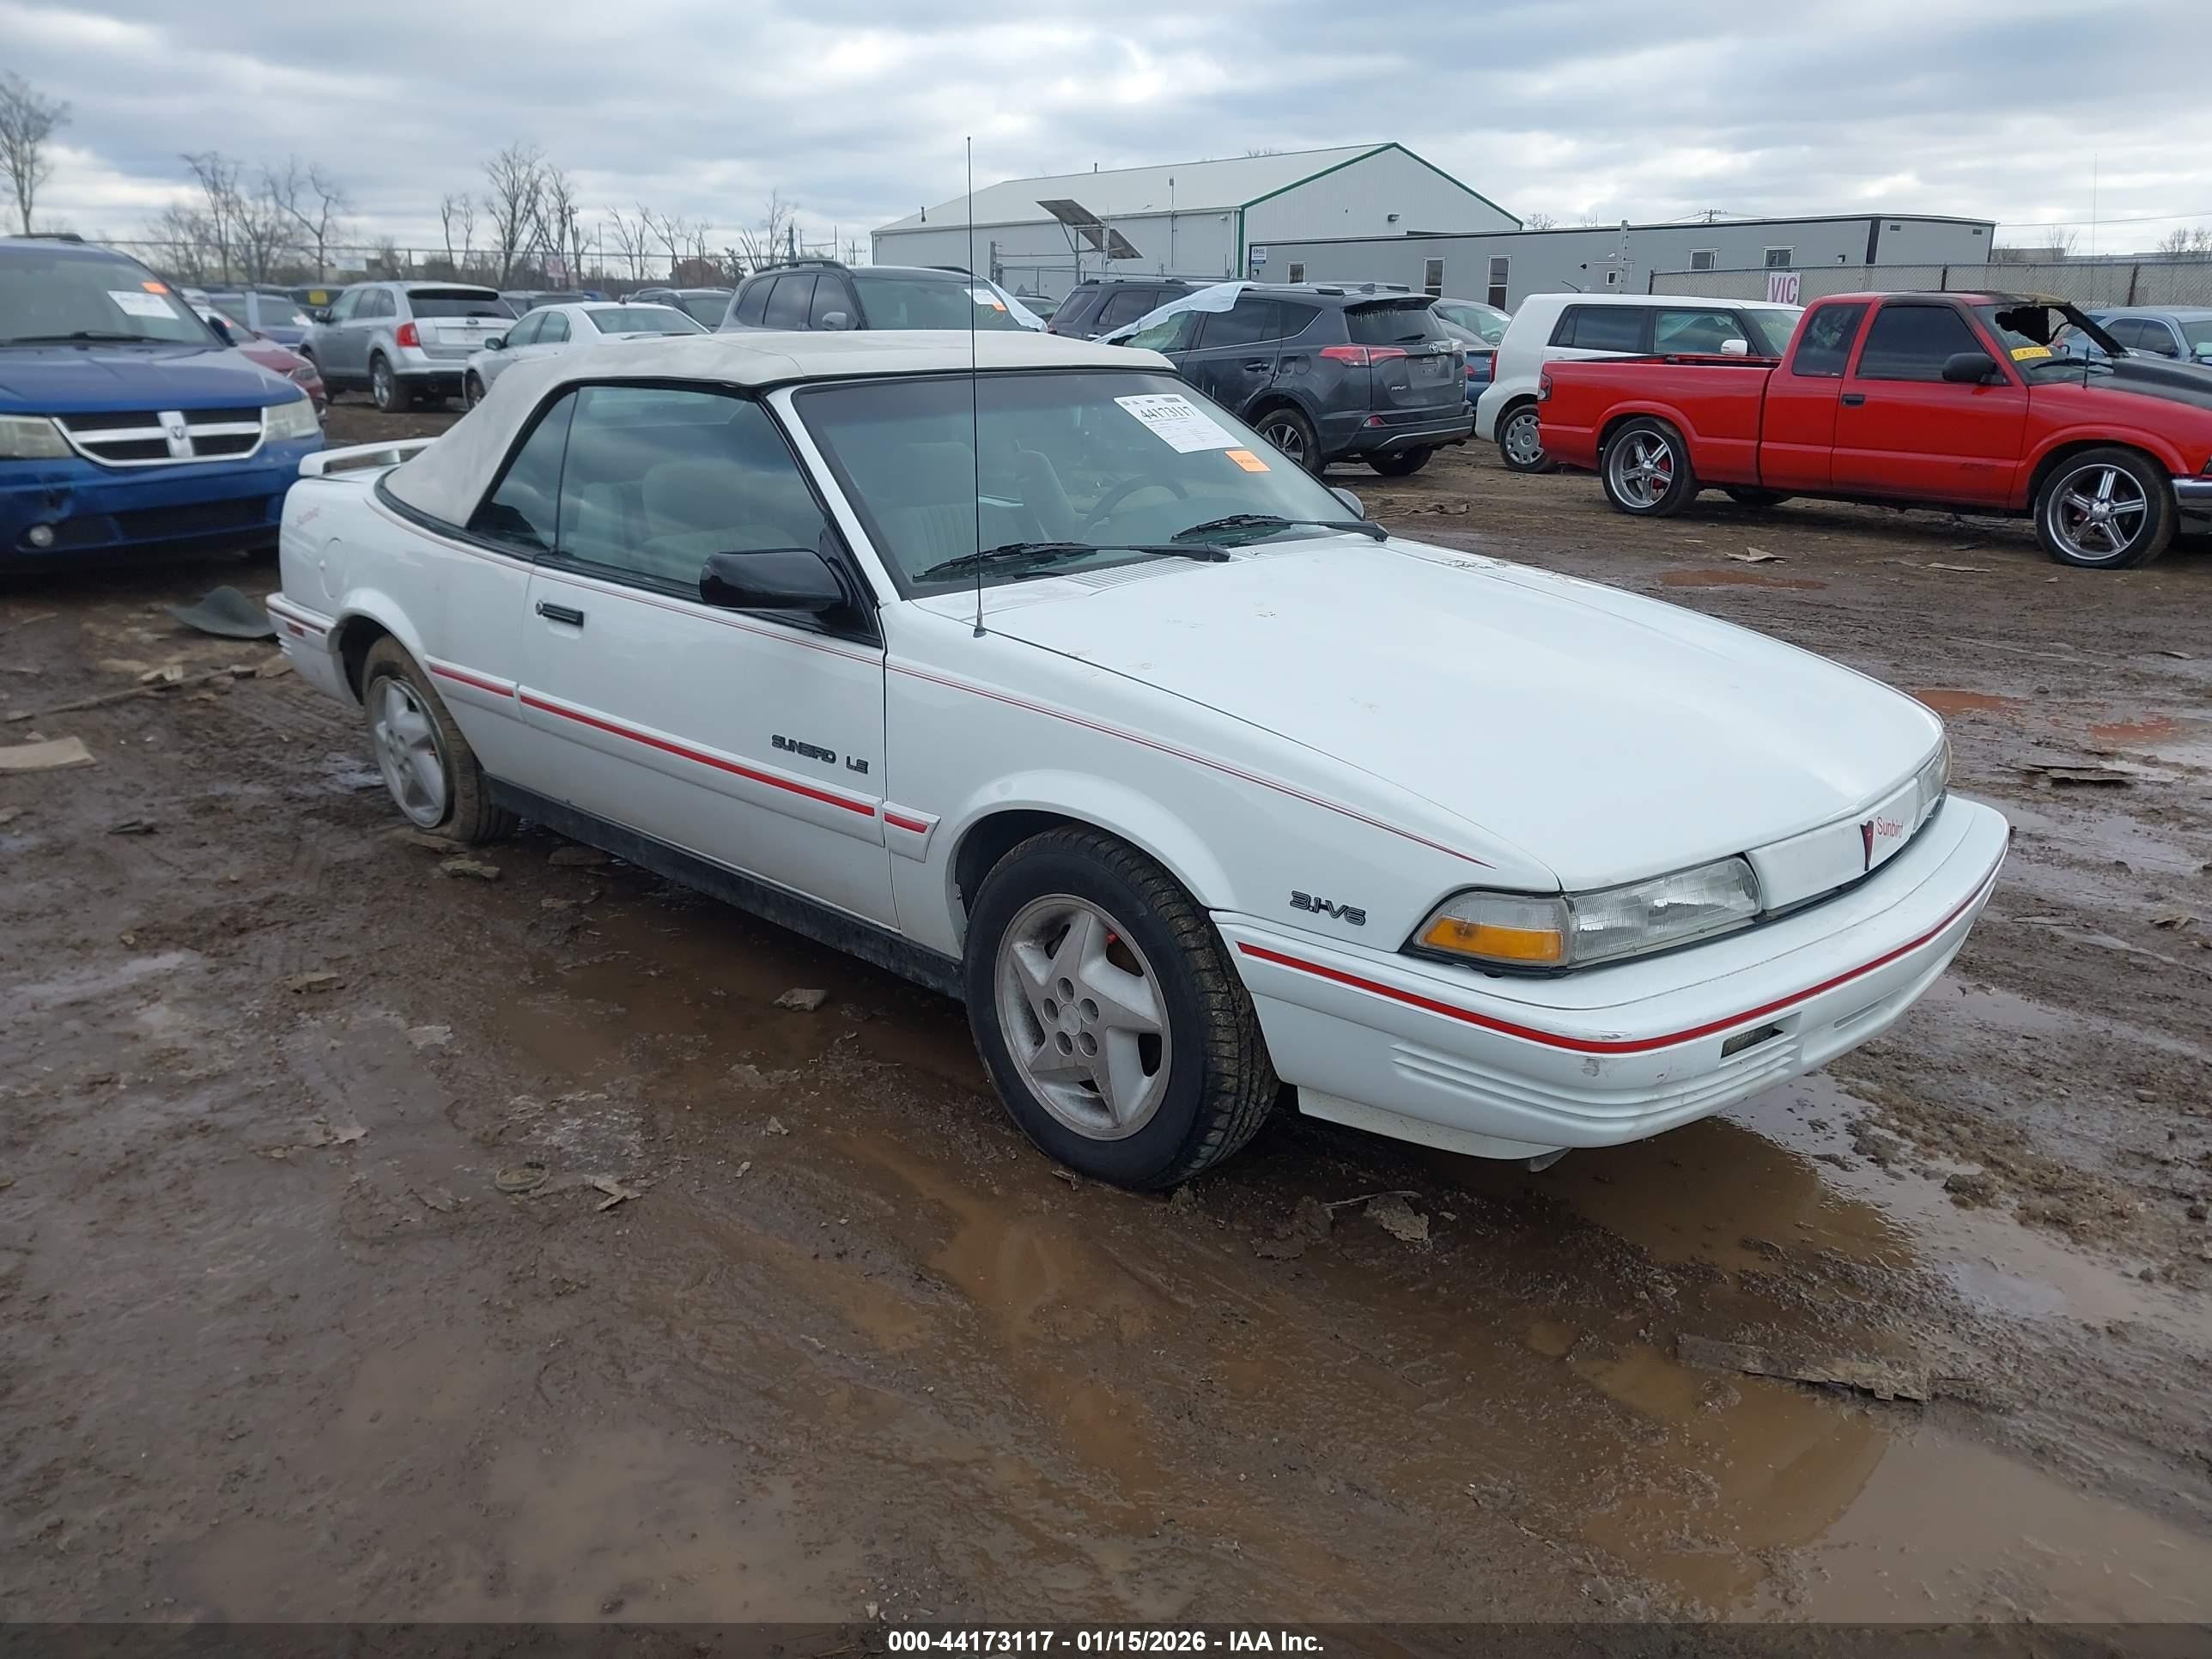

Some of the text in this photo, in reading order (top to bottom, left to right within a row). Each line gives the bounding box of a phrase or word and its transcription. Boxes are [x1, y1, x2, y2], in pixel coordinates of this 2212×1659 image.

[1771, 276, 1797, 304] VIC
[1139, 405, 1196, 419] 44173117
[846, 756, 868, 775] LE
[1877, 817, 1904, 839] Sunbird
